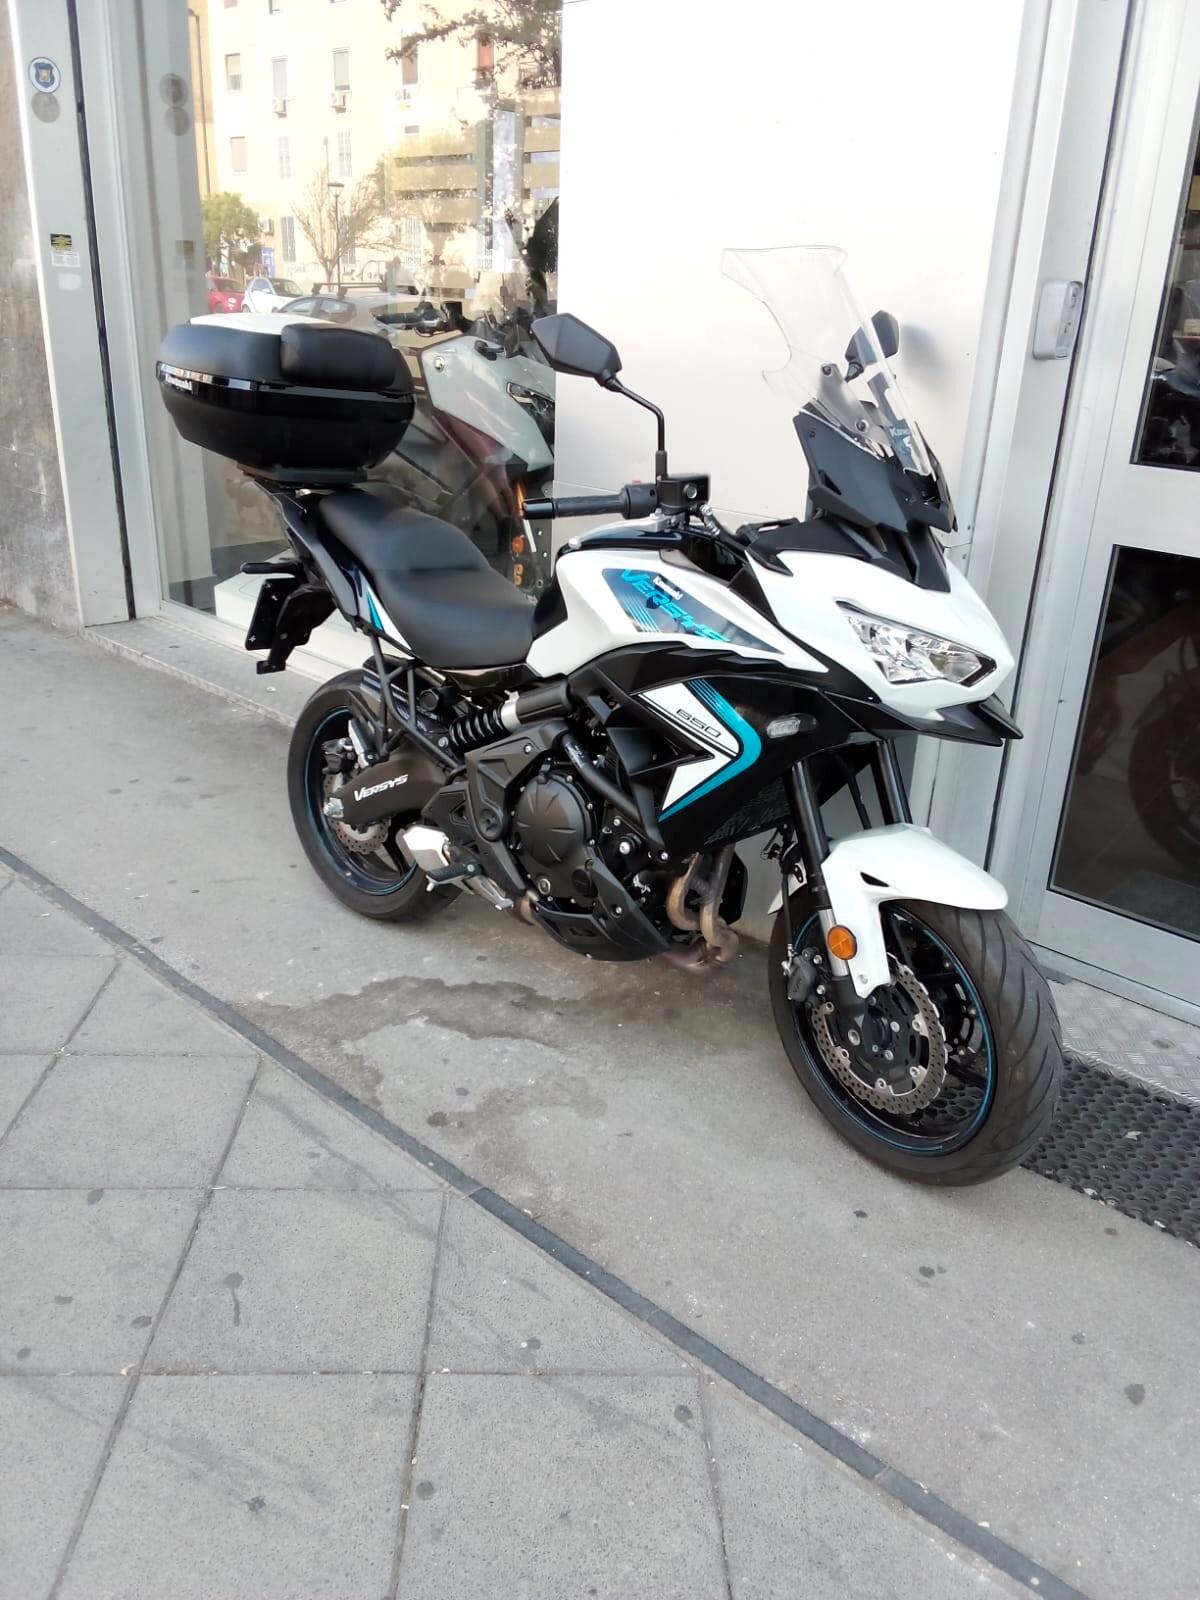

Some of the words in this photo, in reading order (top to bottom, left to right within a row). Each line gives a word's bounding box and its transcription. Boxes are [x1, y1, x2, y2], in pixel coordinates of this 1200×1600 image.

[621, 568, 730, 642] VERSYS
[676, 708, 722, 739] 650
[353, 773, 409, 802] VERSYS
